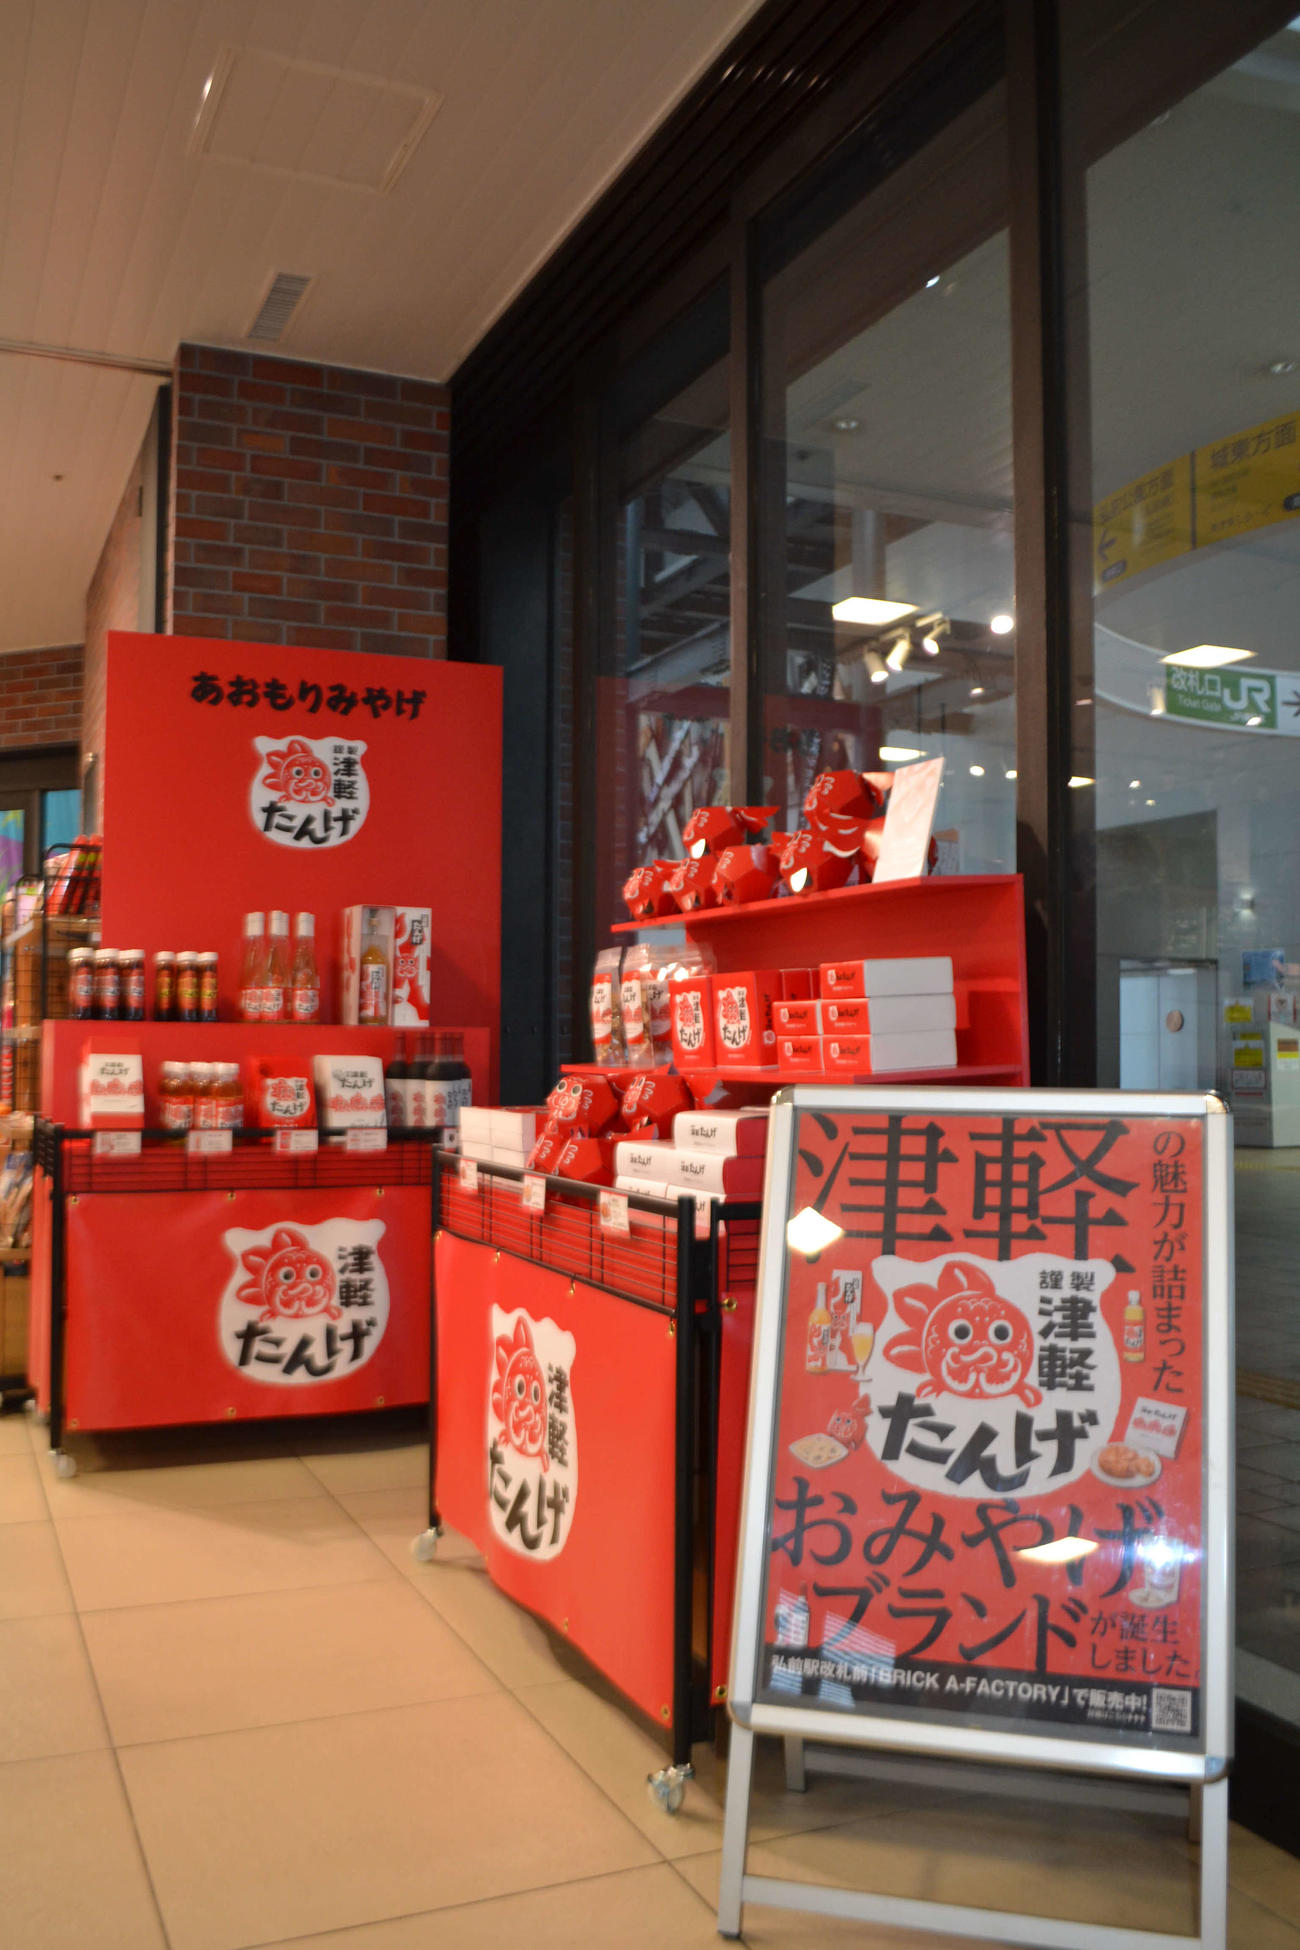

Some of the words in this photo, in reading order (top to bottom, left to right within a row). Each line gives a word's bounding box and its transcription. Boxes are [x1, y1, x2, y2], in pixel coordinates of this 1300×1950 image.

[191, 671, 428, 721] あおもりみやげ
[1171, 666, 1221, 697] 改札口
[1222, 677, 1272, 714] JR
[333, 757, 360, 801] 津軽
[261, 801, 361, 845] たんげ
[722, 1024, 748, 1047] たんげ
[799, 1113, 1141, 1273] 津軽
[337, 1244, 376, 1308] 津軽
[1038, 1268, 1097, 1292] 謹製
[1151, 1130, 1188, 1394] の魅力が詰まった
[234, 1317, 378, 1378] たんげ
[1037, 1294, 1098, 1393] 津軽
[547, 1361, 569, 1468] 津軽
[877, 1391, 1100, 1493] たんげ
[489, 1437, 570, 1551] たんげ
[770, 1476, 1165, 1599] おみやげ
[813, 1570, 1089, 1675] ブランド
[1090, 1610, 1180, 1646] が誕生
